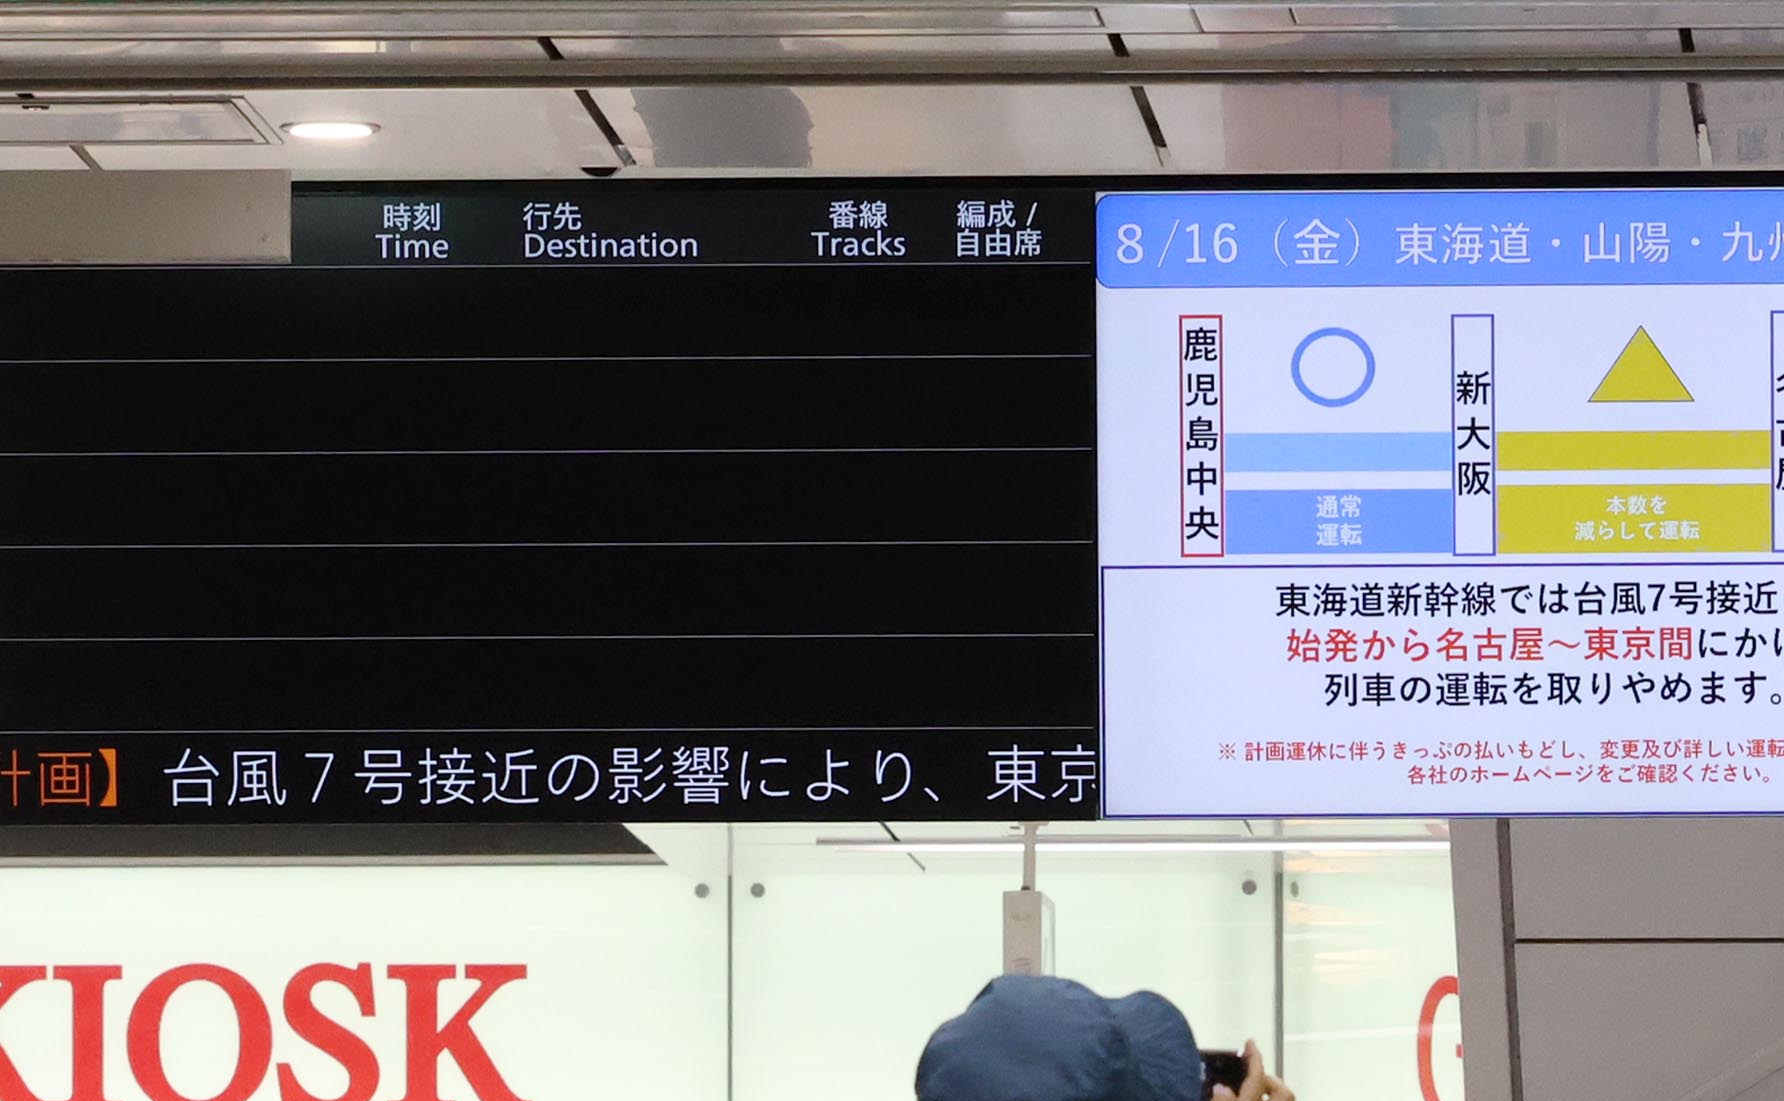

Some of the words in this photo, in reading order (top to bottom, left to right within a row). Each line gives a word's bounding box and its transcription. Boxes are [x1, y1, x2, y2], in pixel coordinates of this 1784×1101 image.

[381, 202, 442, 233] 時刻
[521, 202, 582, 233] 行先
[827, 200, 889, 231] 番線
[375, 230, 450, 262] Time
[522, 230, 700, 262] Destination
[811, 228, 907, 260] Tracks
[953, 227, 1043, 258] 自由席
[1183, 326, 1221, 540] 鹿児島中央
[1455, 370, 1492, 497] 新大阪
[1315, 493, 1362, 518] 通常
[1605, 494, 1665, 517] 本数を
[1315, 521, 1363, 547] 運転
[1573, 519, 1700, 542] 減らして運転
[1323, 671, 1784, 708] 列車の運転を取りやめます。
[1407, 762, 1772, 786] 各社のホームページをご確認ください。
